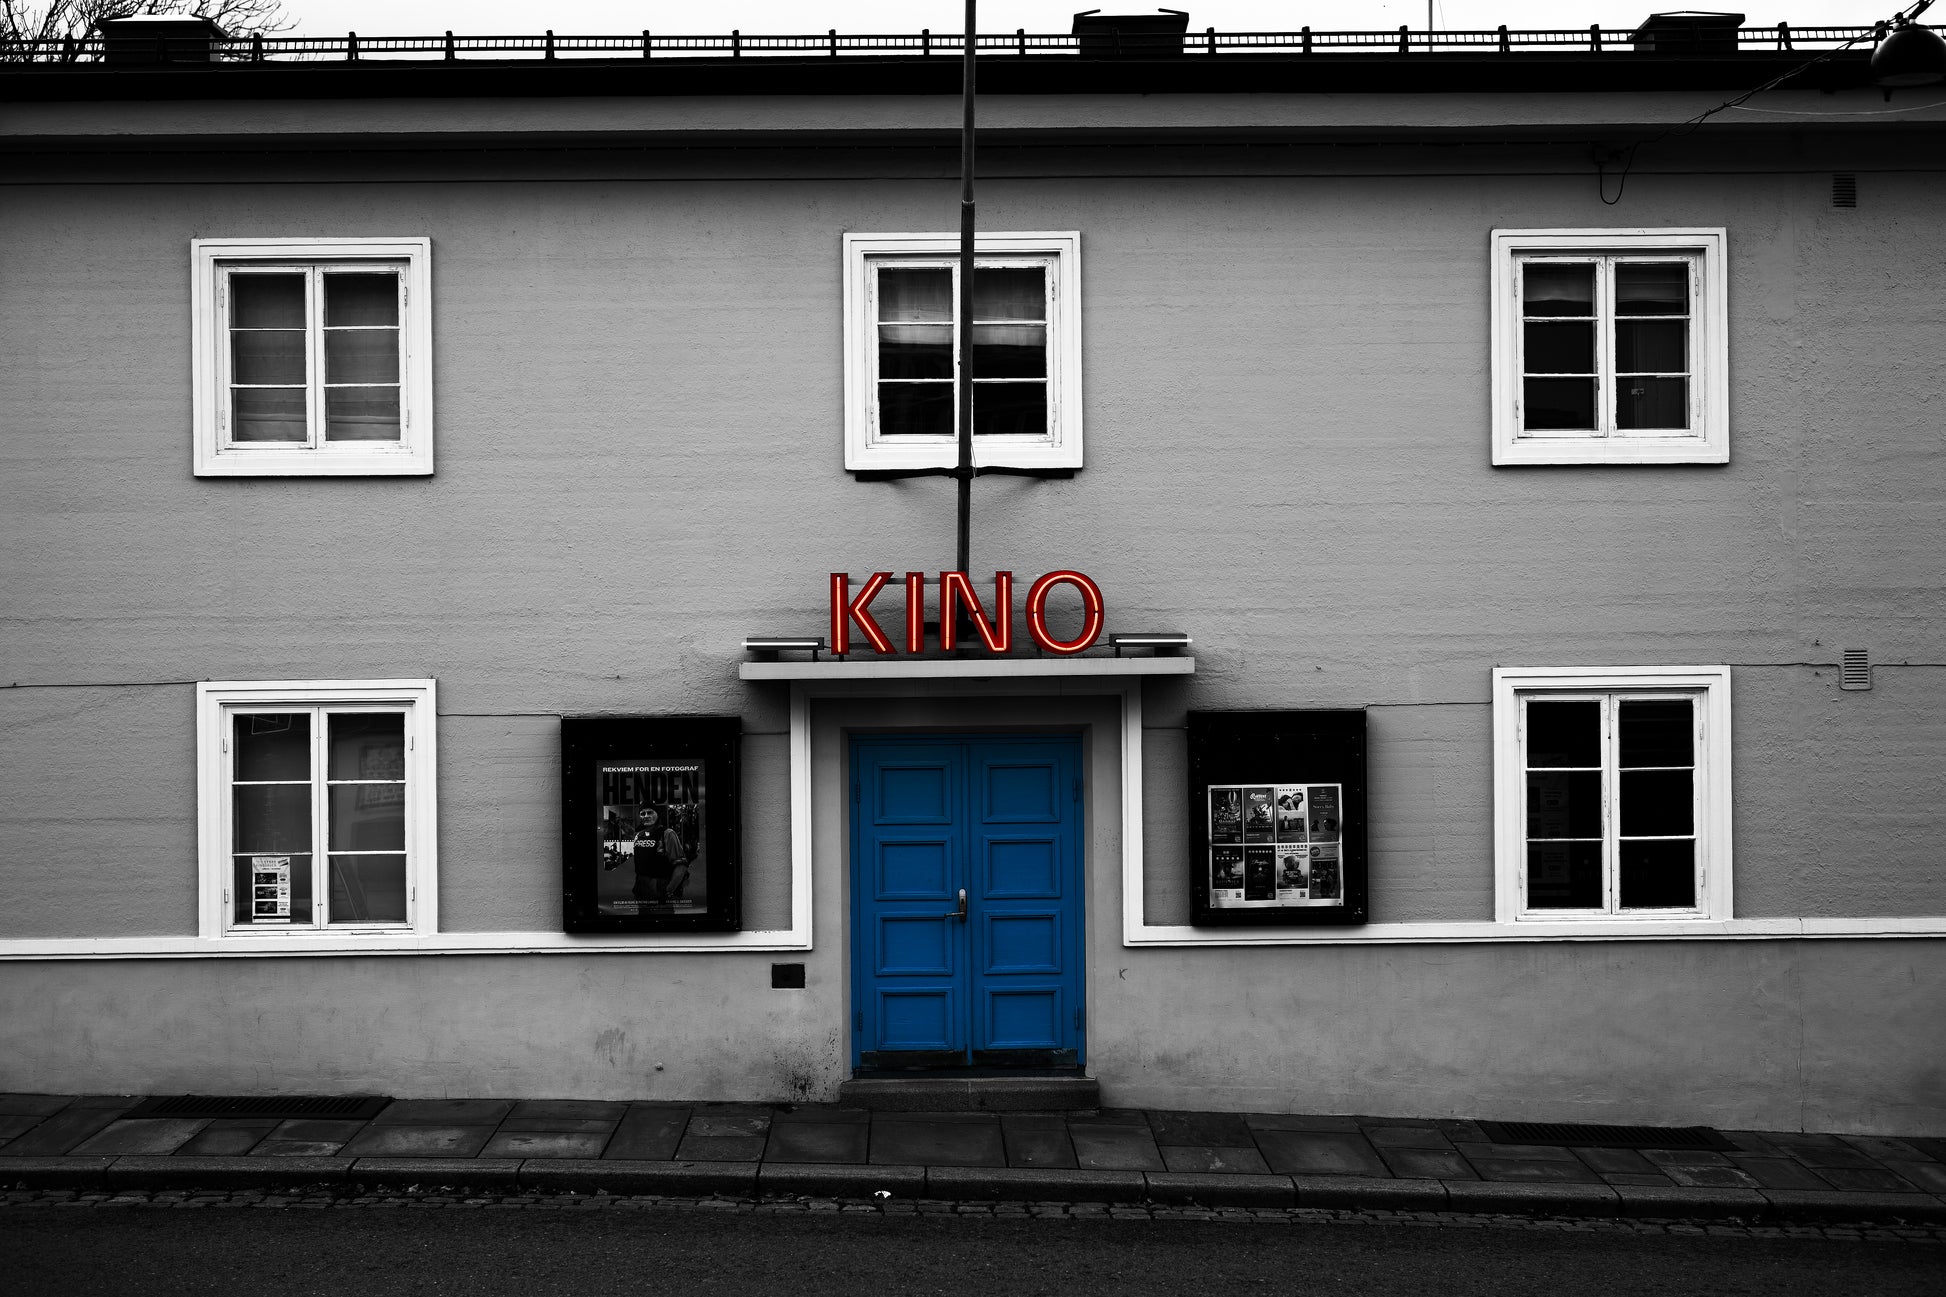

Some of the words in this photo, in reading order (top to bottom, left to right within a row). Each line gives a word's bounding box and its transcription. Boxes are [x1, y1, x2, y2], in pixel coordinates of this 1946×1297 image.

[830, 570, 1105, 655] KINO
[603, 772, 698, 804] HENDEN
[635, 839, 656, 847] PRESS
